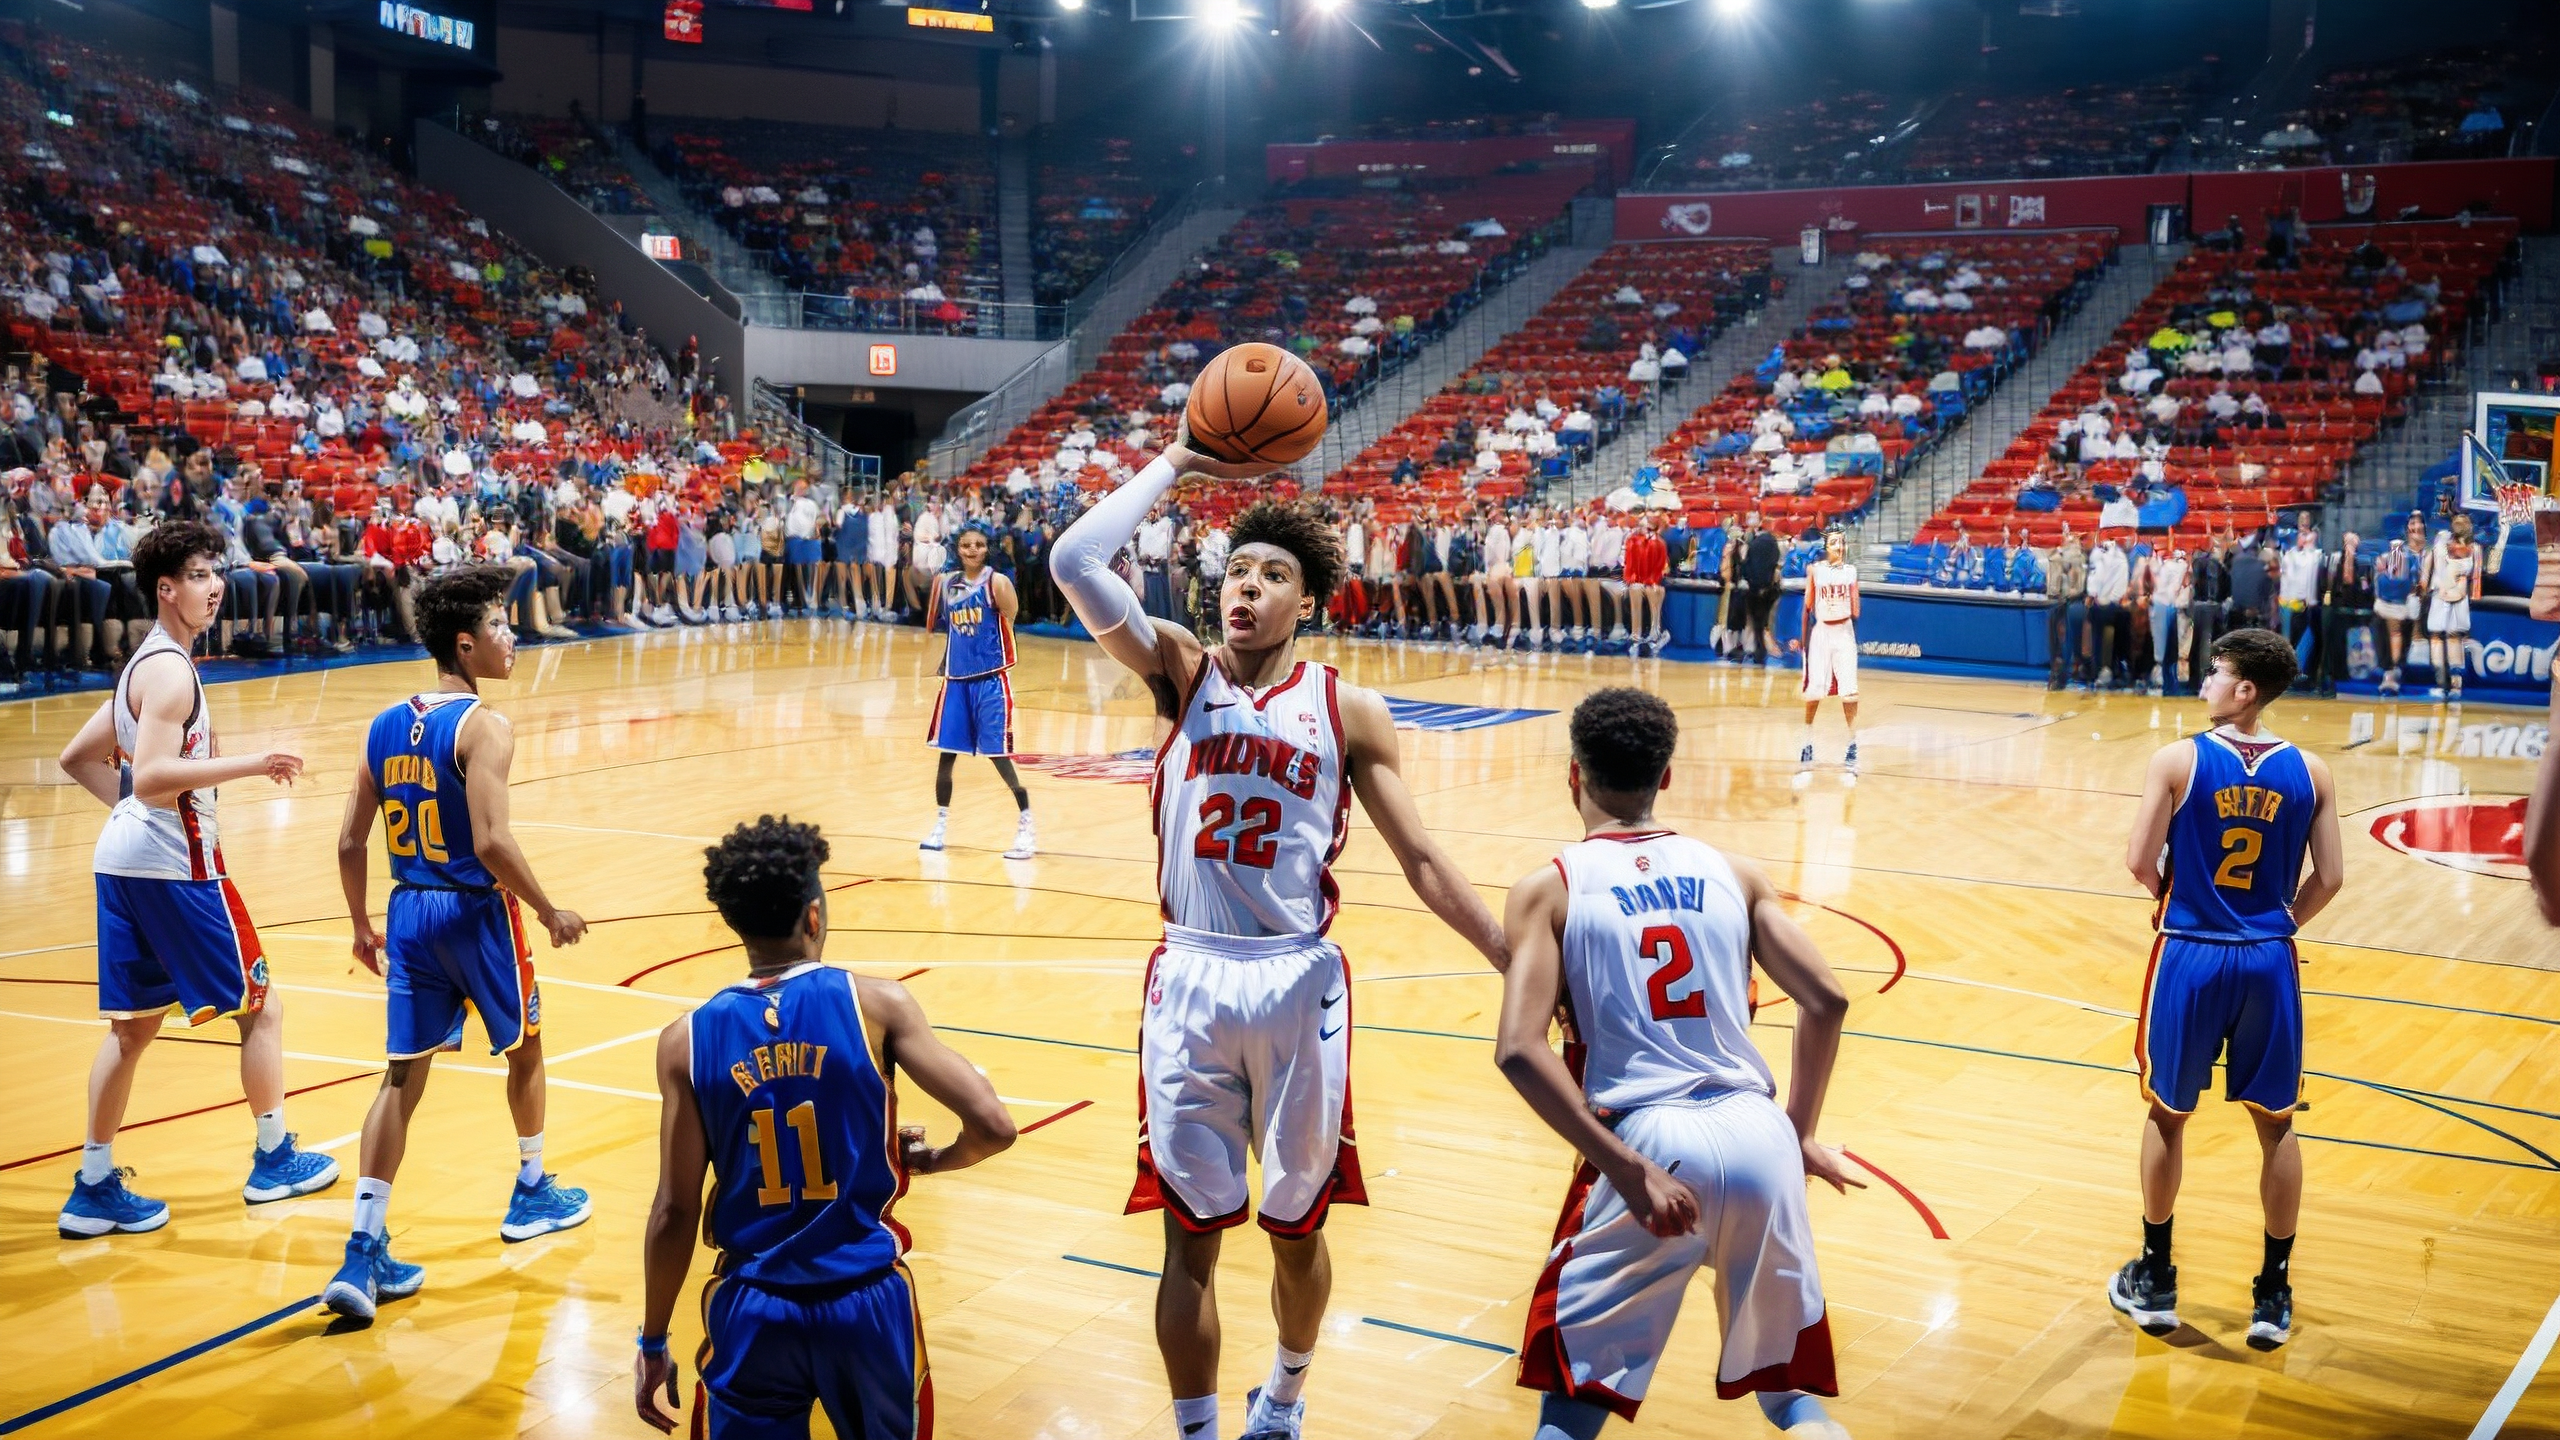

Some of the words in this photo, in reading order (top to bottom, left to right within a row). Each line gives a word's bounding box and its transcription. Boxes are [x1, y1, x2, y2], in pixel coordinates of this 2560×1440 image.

[1195, 792, 1282, 869] 22
[2213, 827, 2263, 890] 2
[1639, 924, 1707, 1021] 2
[751, 1100, 838, 1208] 11
